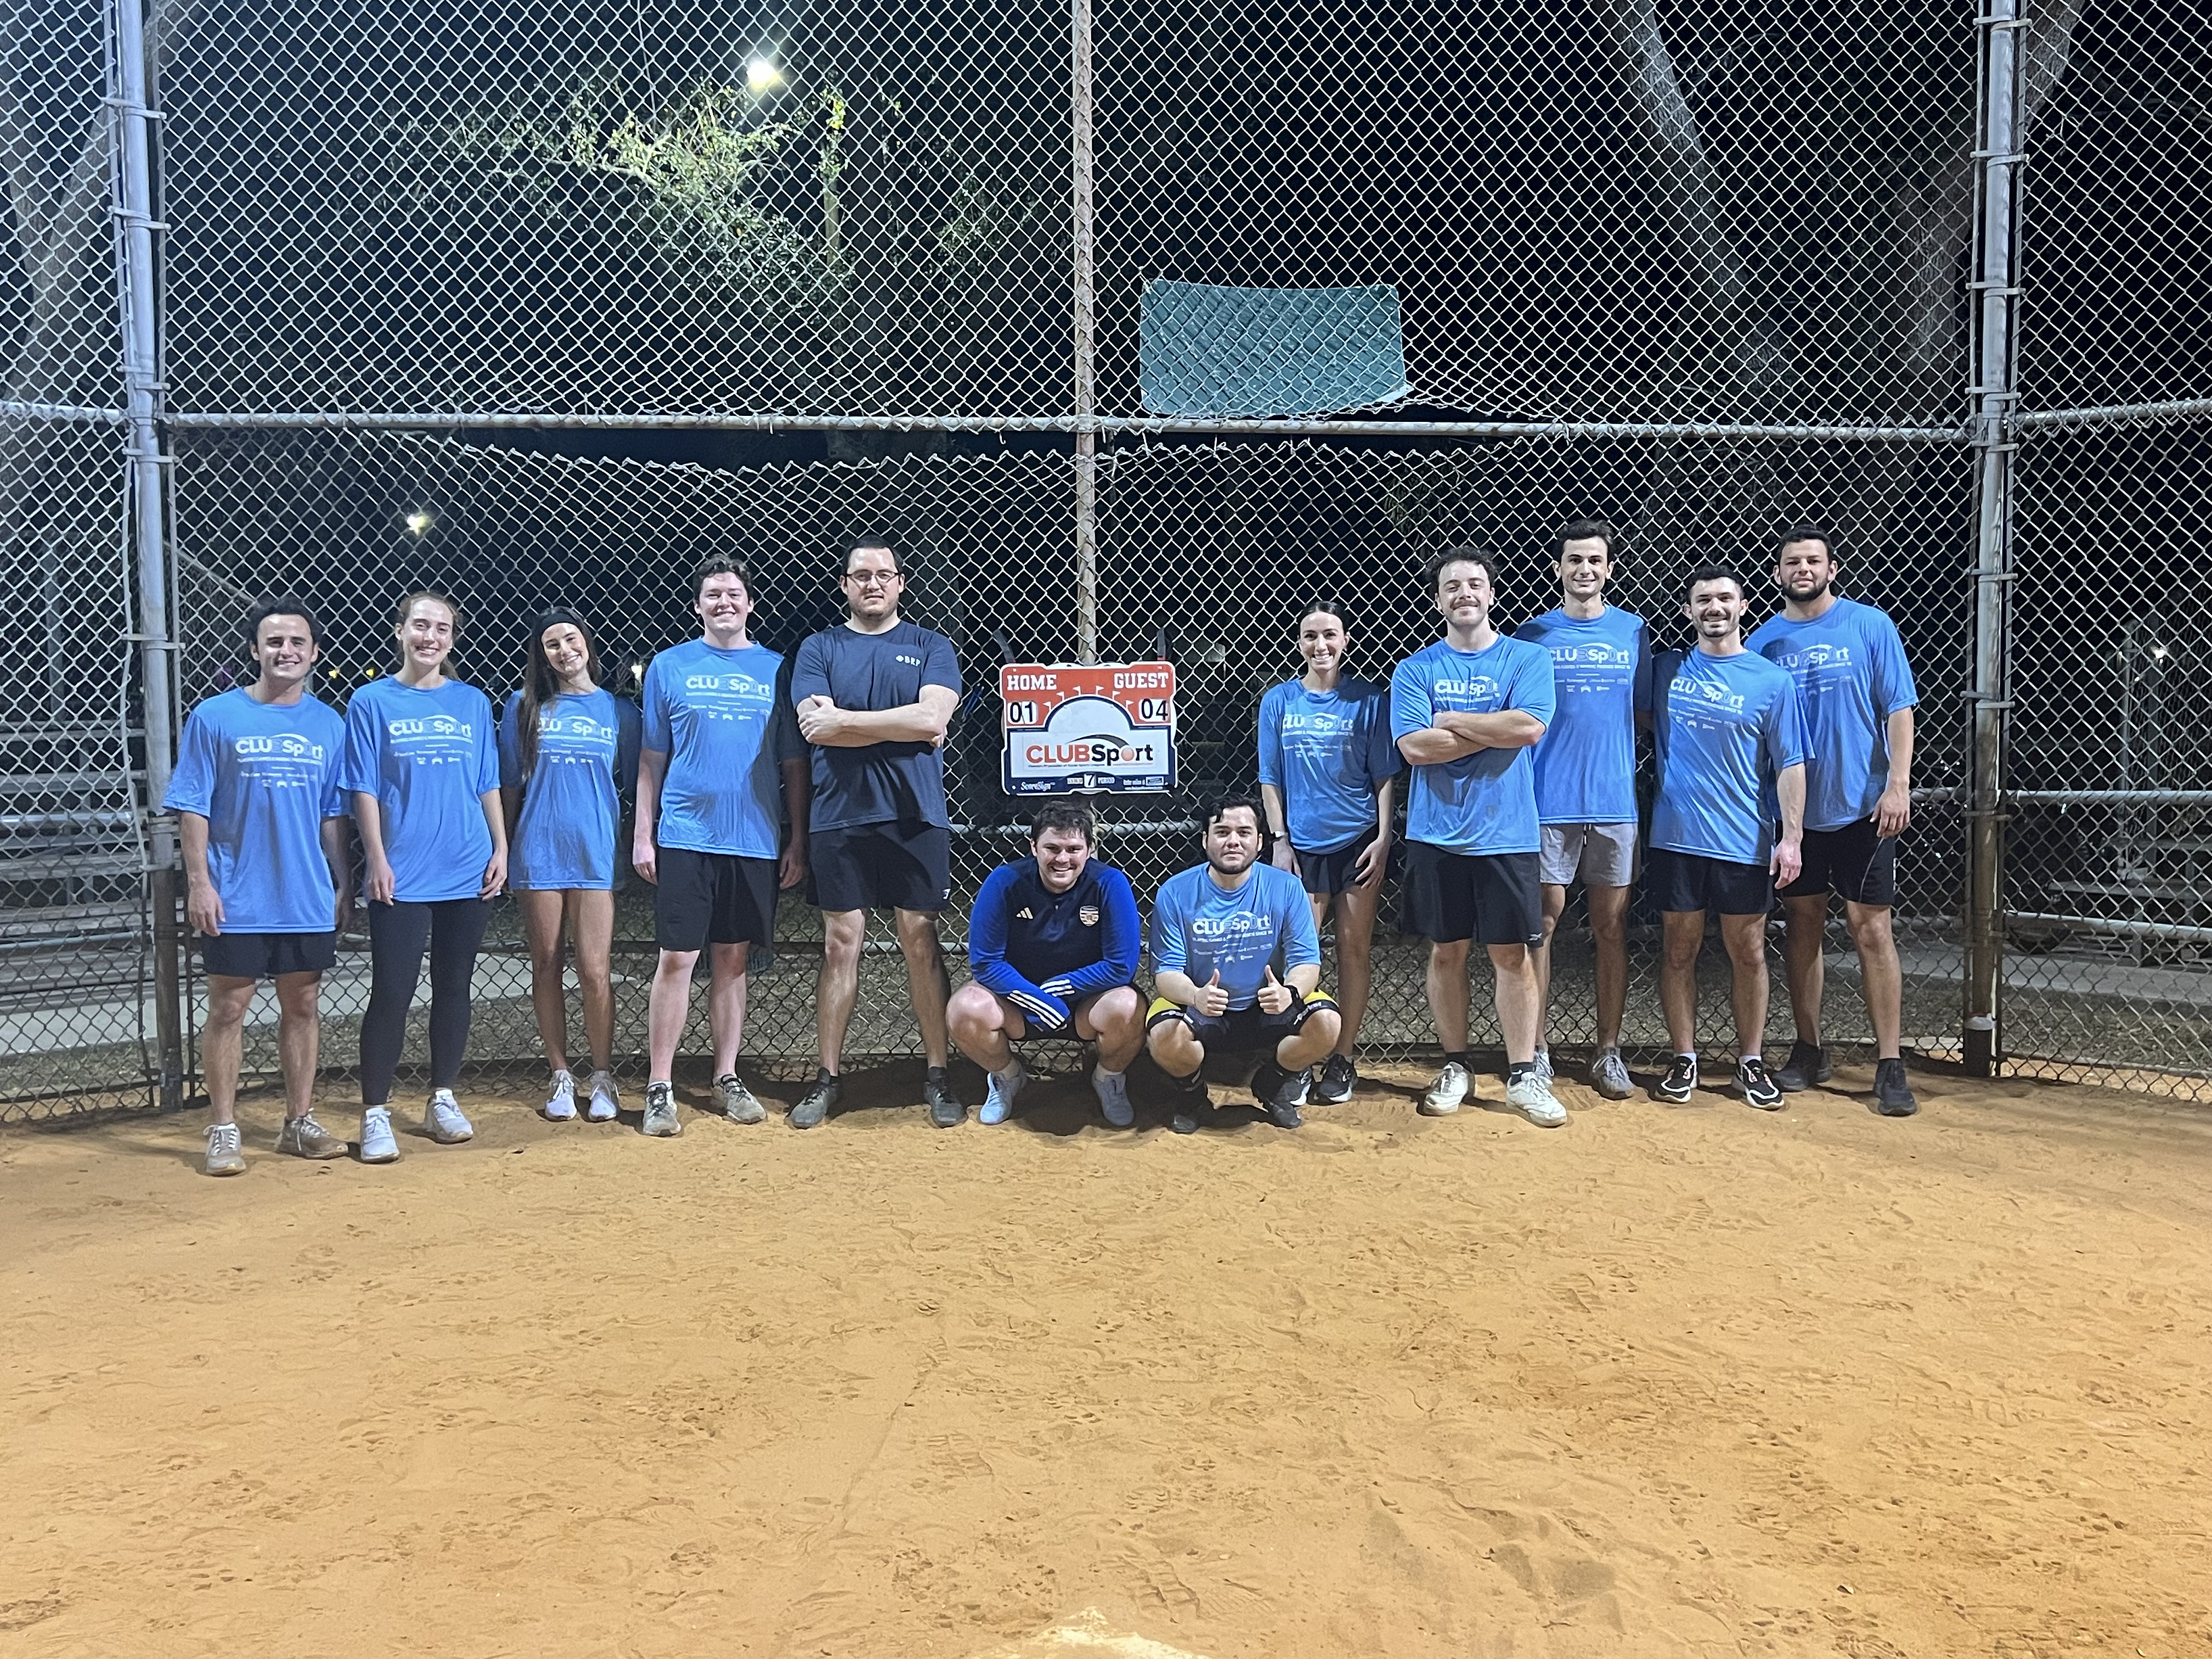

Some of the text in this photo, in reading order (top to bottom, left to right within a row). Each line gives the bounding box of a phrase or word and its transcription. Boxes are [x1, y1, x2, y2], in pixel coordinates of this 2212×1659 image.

[905, 656, 921, 667] BRP
[1007, 672, 1169, 691] HOME GUEST
[1009, 701, 1034, 723] 01
[1141, 698, 1169, 720] 04
[1086, 774, 1094, 786] 7
